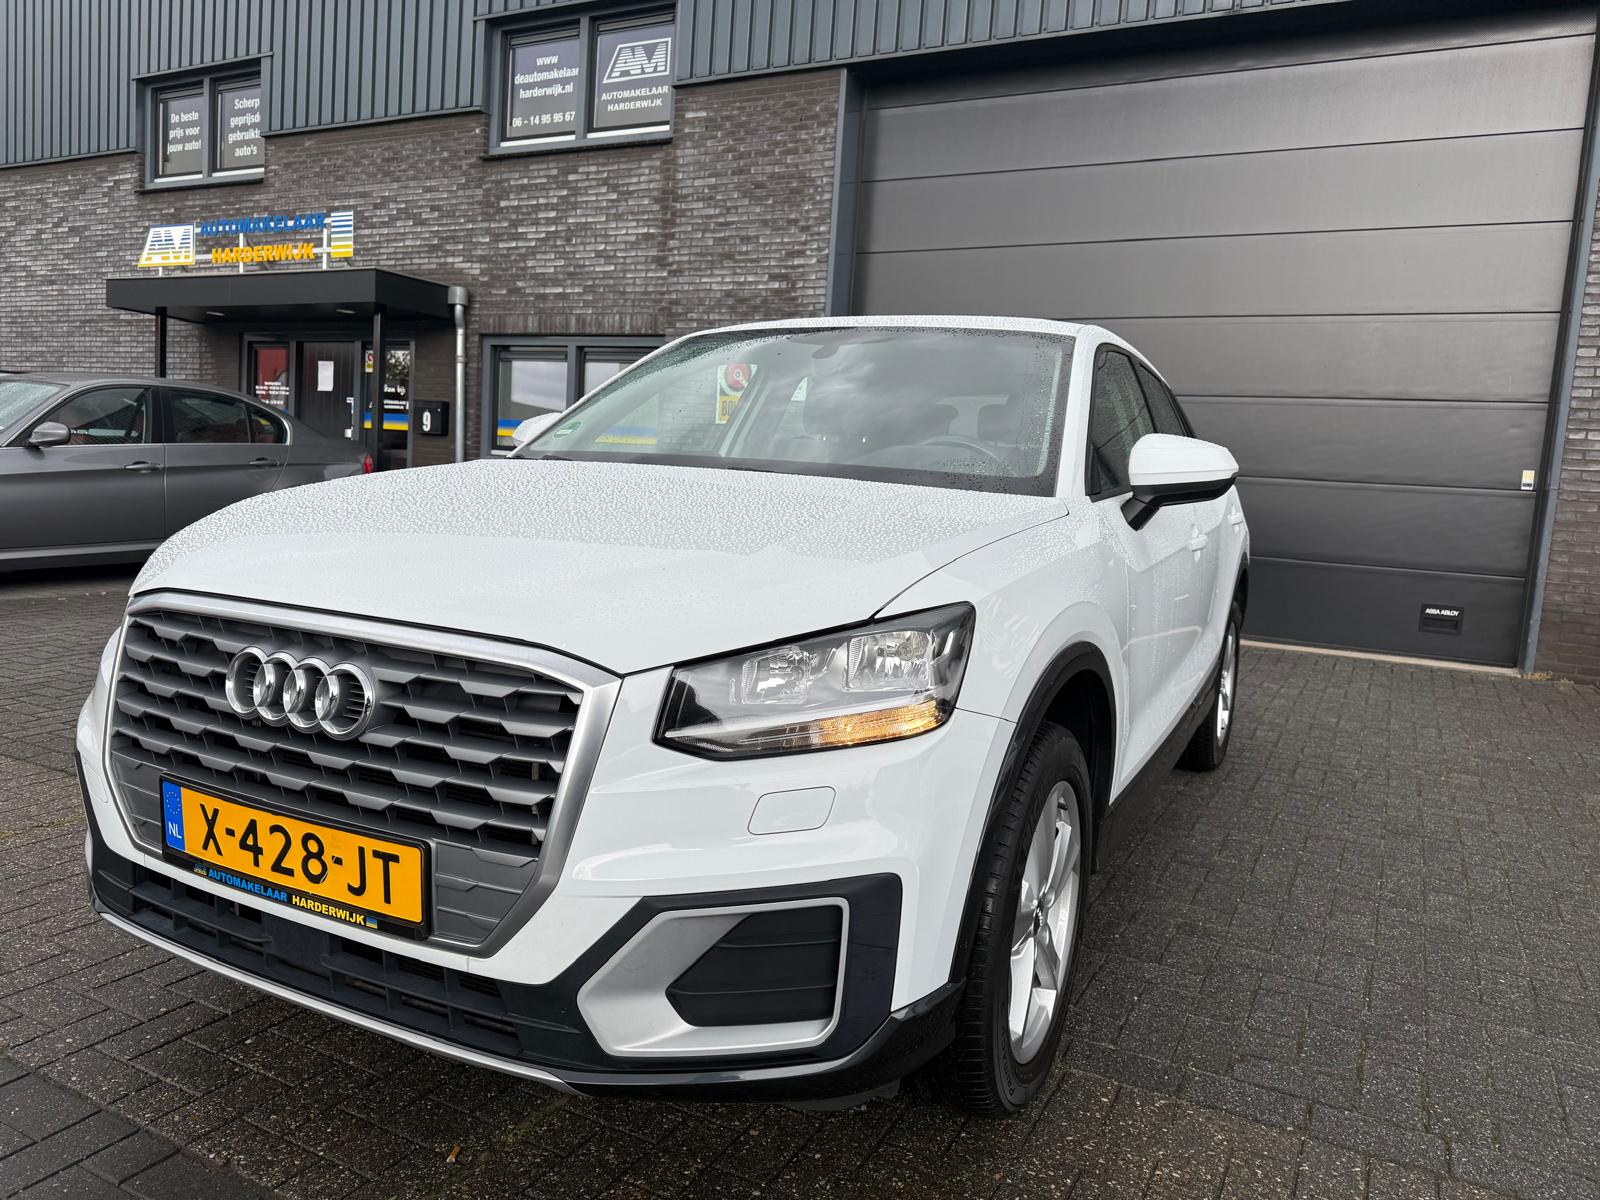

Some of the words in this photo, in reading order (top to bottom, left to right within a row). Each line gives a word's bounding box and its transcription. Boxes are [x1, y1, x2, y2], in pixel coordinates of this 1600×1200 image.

[536, 55, 559, 66] www
[514, 67, 579, 85] deautomakelaar
[519, 82, 573, 99] harderwijk.nl
[601, 85, 669, 101] AUTOMAKELAAR
[234, 98, 260, 109] Scherp
[607, 98, 663, 112] HARDERWIJK
[170, 113, 180, 123] De
[180, 111, 199, 122] beste
[512, 117, 523, 128] 06
[530, 115, 540, 126] 14
[541, 113, 551, 125] 95
[553, 112, 563, 124] 95
[565, 111, 576, 122] 67
[169, 127, 184, 140] prijs
[185, 126, 201, 136] voor
[167, 142, 184, 155] jouw
[184, 139, 202, 150] auto!
[234, 144, 258, 157] auto's
[200, 211, 327, 237] AUTOMAKELAAR
[211, 242, 315, 264] HARDERWIJK
[422, 411, 431, 431] 9
[167, 821, 183, 840] NL
[199, 803, 400, 905] X-428-JT
[207, 867, 288, 902] AUTOMAKELAAR
[291, 894, 365, 926] HARDERWIJK
